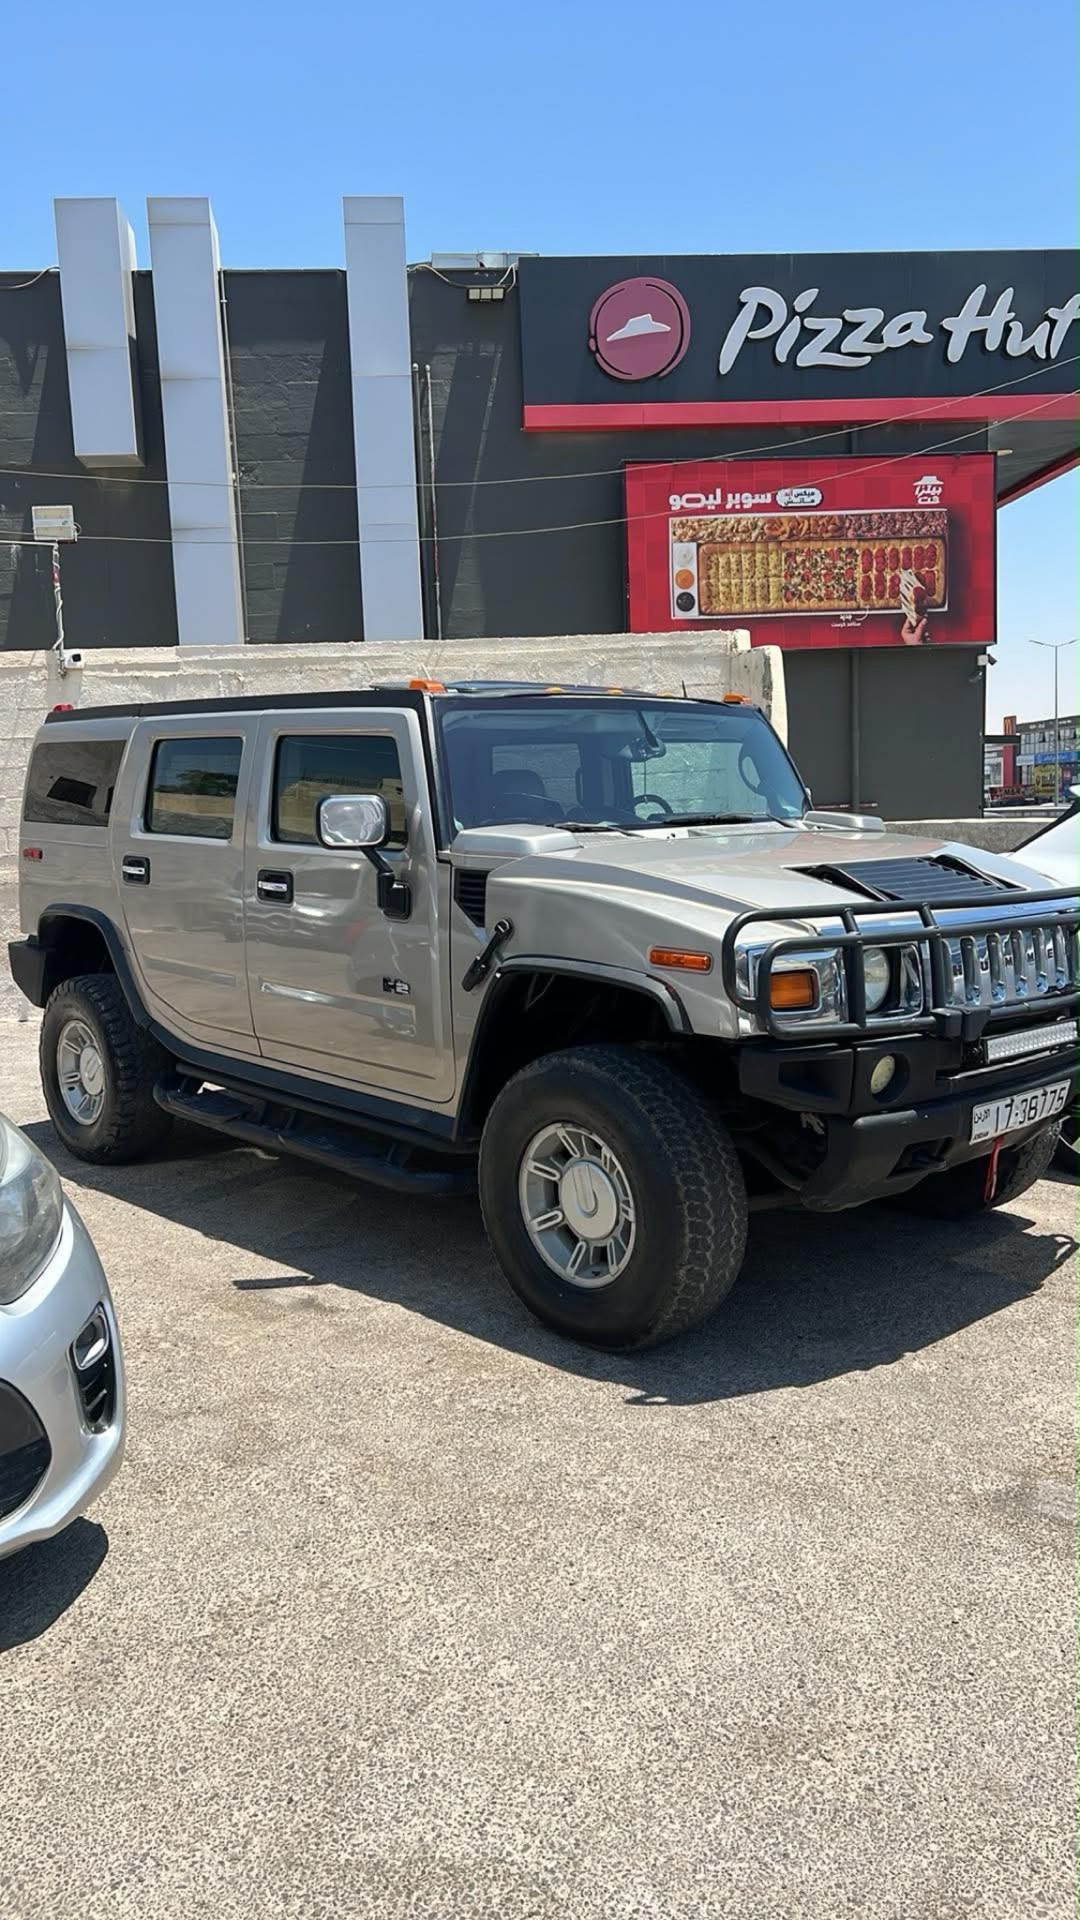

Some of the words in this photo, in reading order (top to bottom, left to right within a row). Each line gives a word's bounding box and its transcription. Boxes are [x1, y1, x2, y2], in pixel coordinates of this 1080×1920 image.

[719, 286, 934, 376] Pizza
[941, 284, 1078, 363] Hut
[726, 492, 772, 509] سوبر
[383, 976, 411, 996] H2
